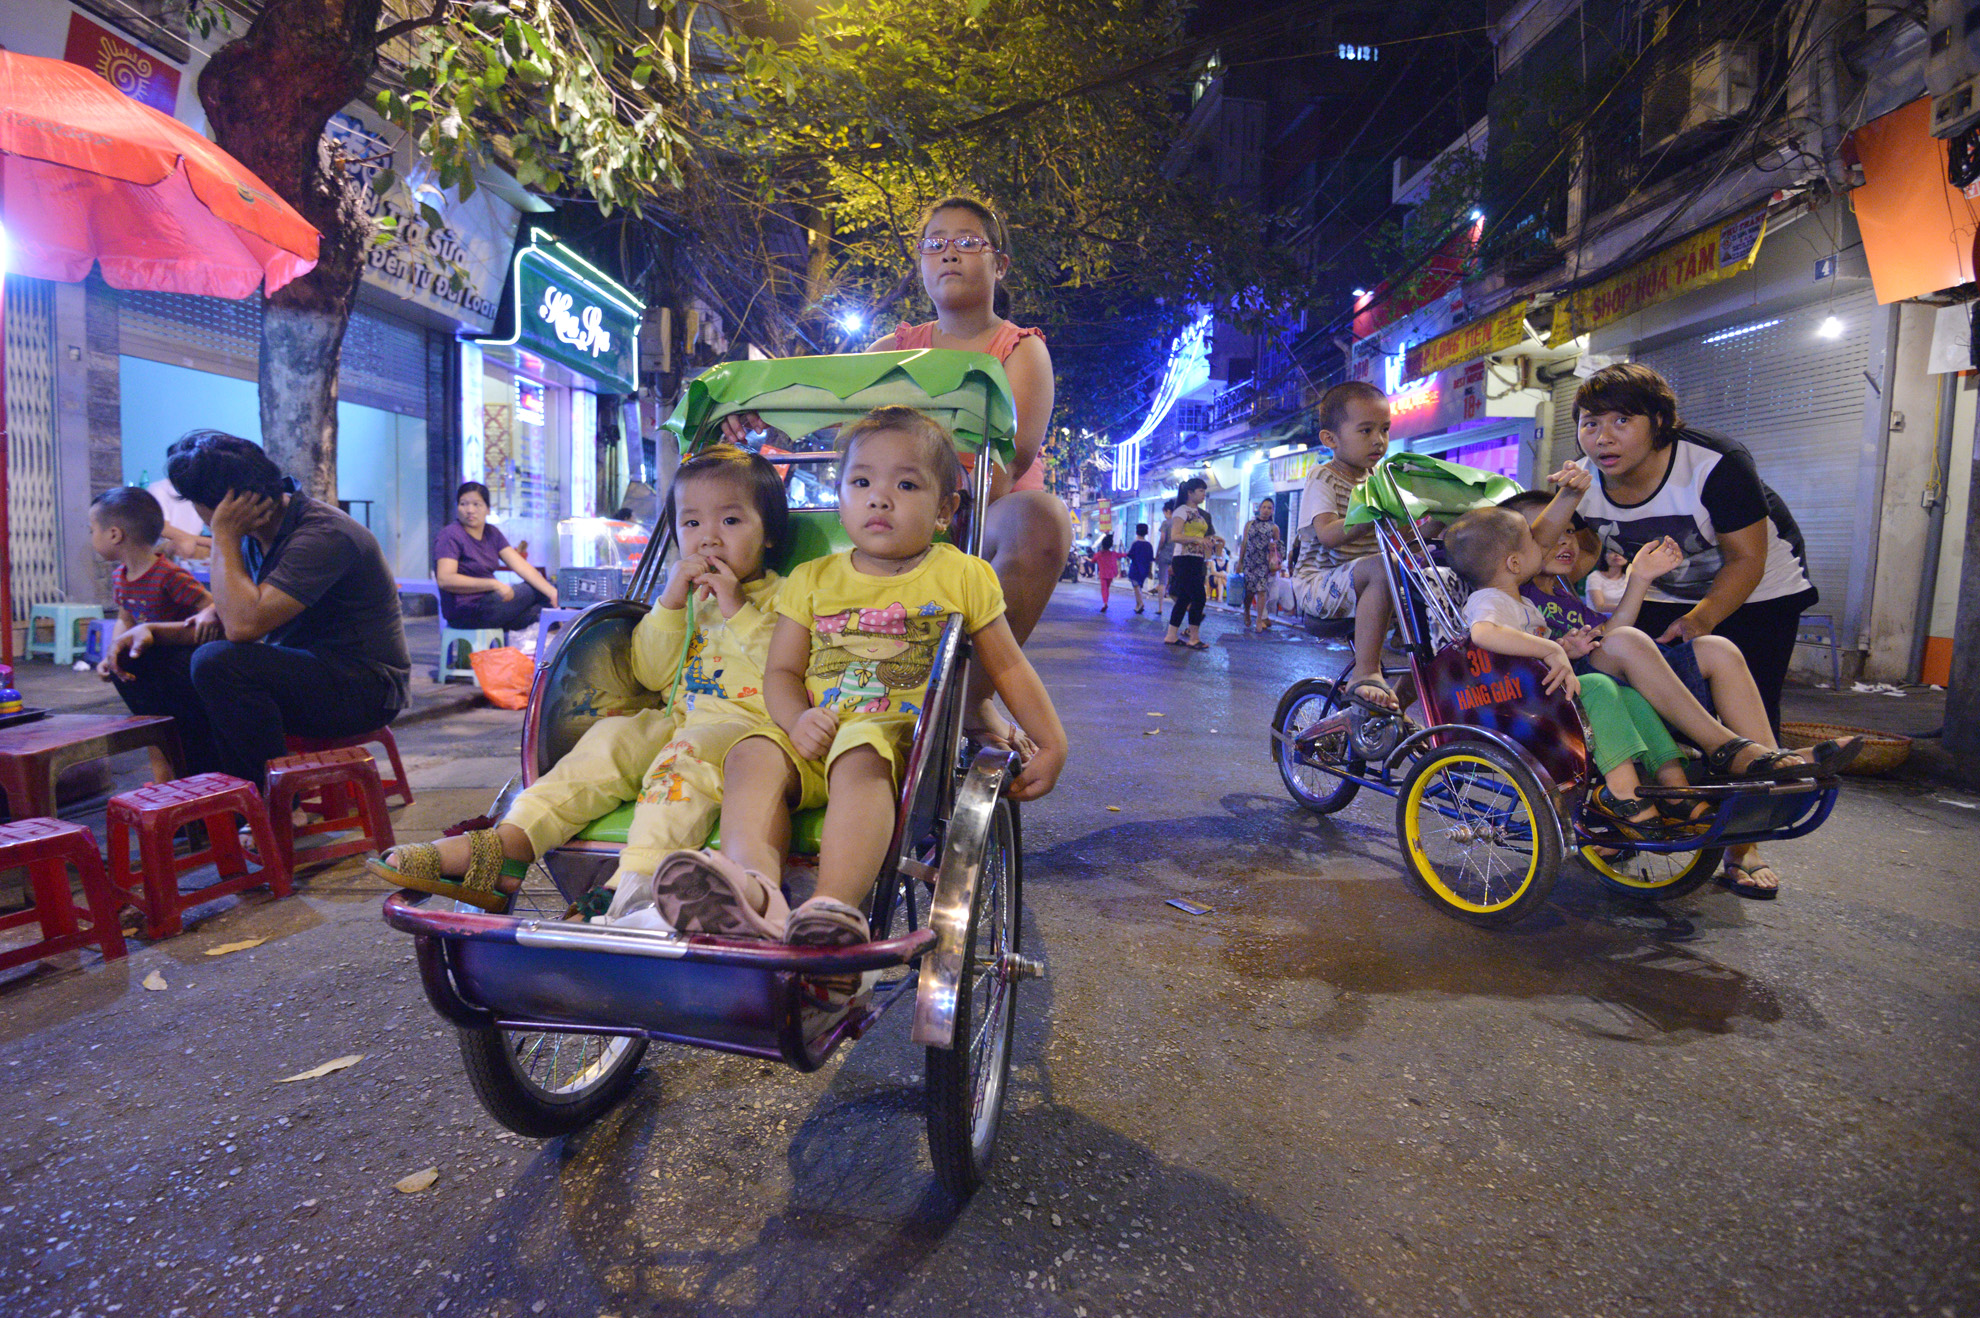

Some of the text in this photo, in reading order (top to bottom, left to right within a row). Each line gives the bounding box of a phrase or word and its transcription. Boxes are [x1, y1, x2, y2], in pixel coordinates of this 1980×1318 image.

[1821, 260, 1831, 276] 4
[463, 287, 498, 320] Loan
[1592, 282, 1632, 321] SHOP
[1467, 648, 1492, 677] 30
